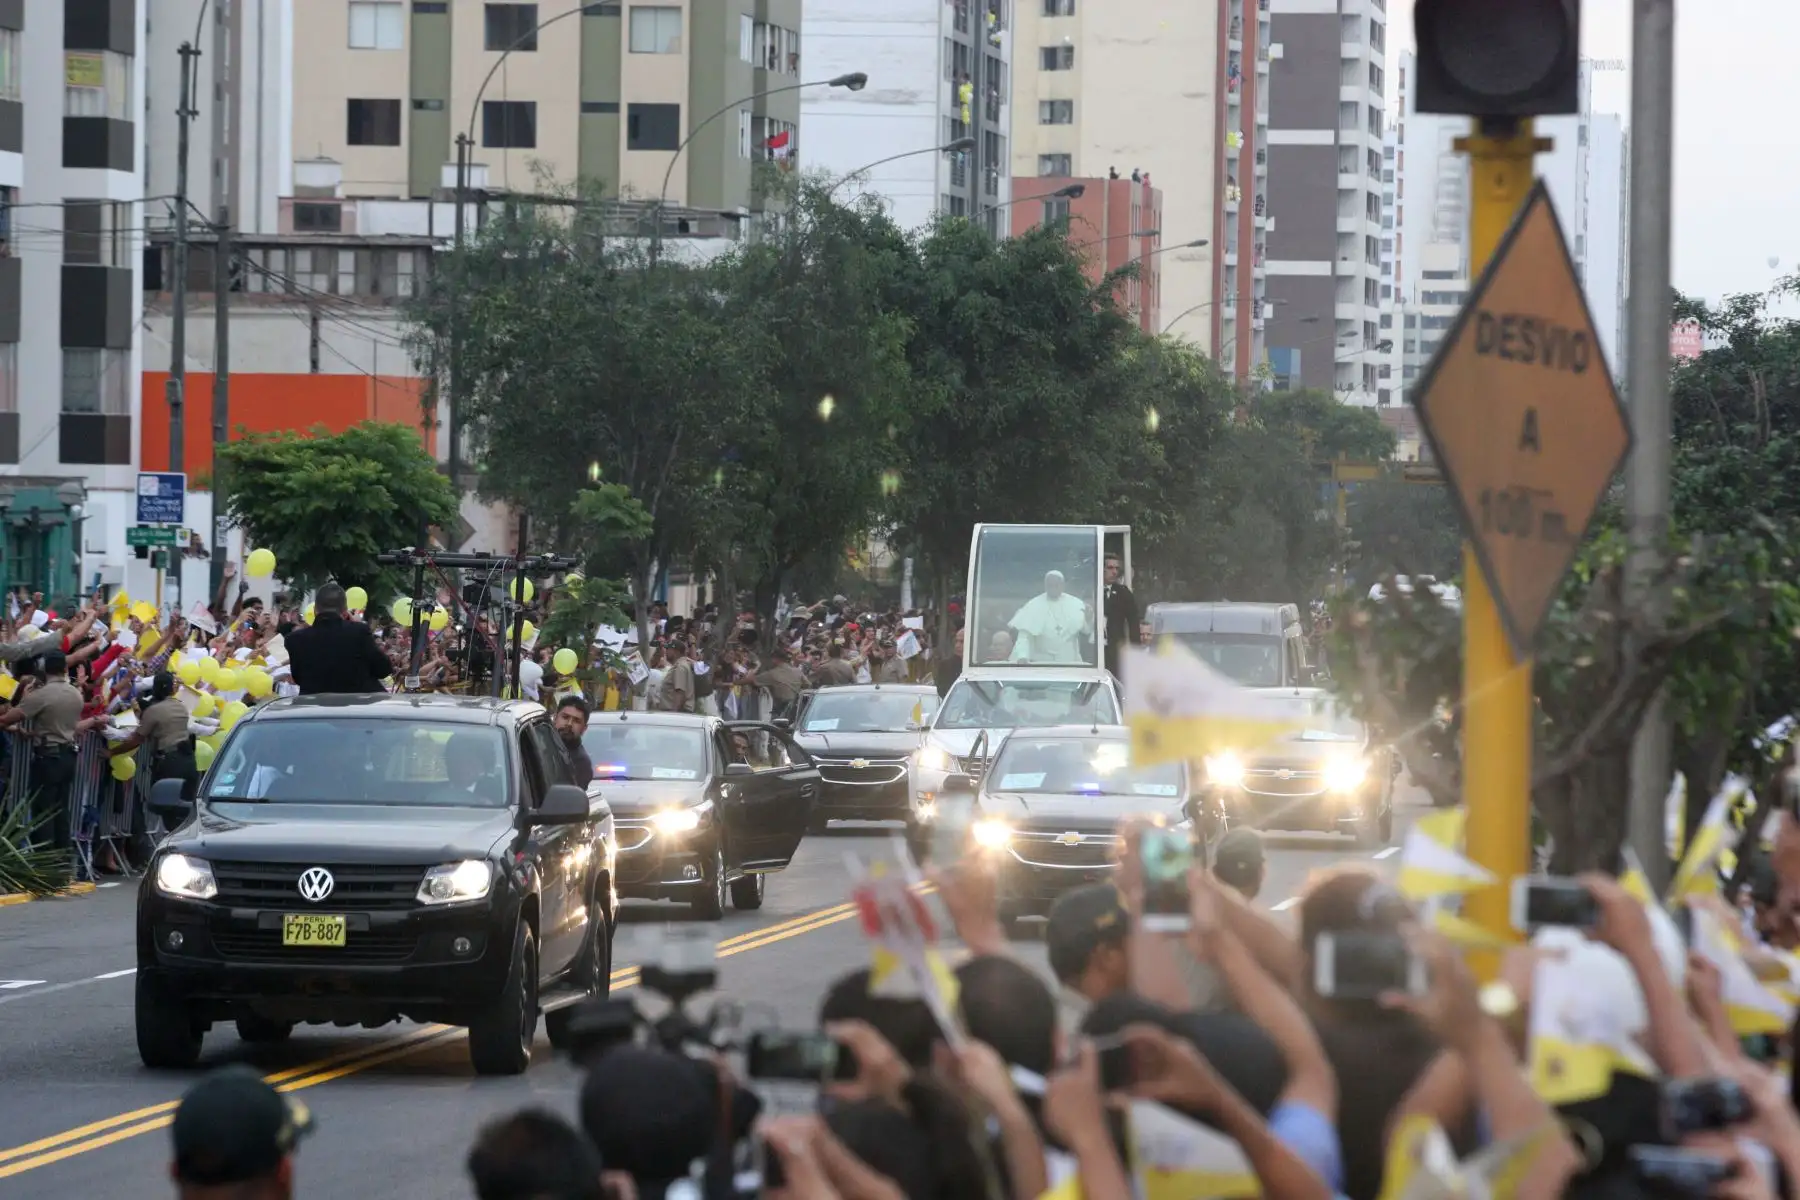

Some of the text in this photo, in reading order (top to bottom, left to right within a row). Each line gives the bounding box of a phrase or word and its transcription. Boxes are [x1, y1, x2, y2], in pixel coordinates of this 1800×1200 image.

[1476, 311, 1589, 375] DESVIO
[1517, 405, 1542, 453] A
[286, 922, 343, 941] F7B-887
